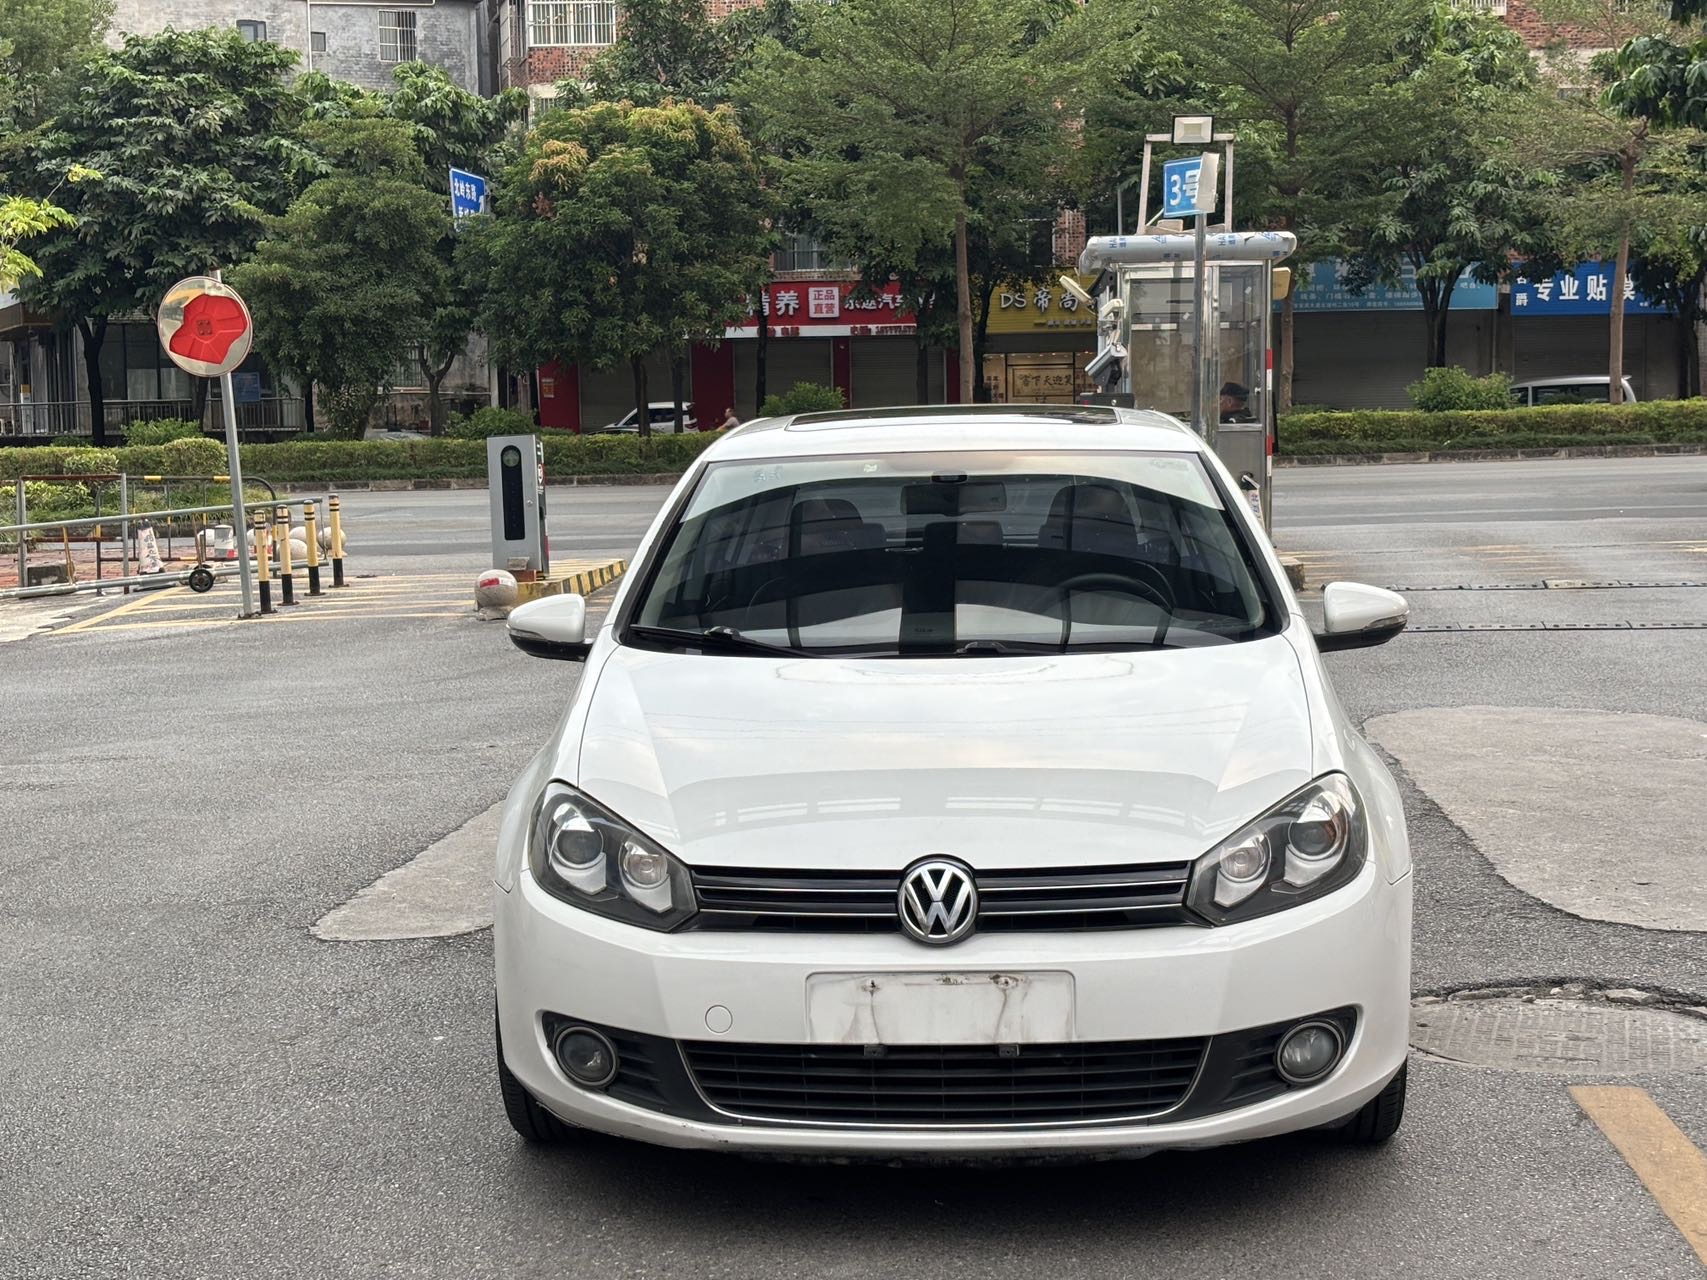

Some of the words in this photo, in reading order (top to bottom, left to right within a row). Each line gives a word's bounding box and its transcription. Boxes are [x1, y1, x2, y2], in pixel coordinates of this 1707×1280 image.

[813, 289, 835, 300] 正品
[1000, 293, 1027, 309] DS
[813, 302, 835, 314] 直营
